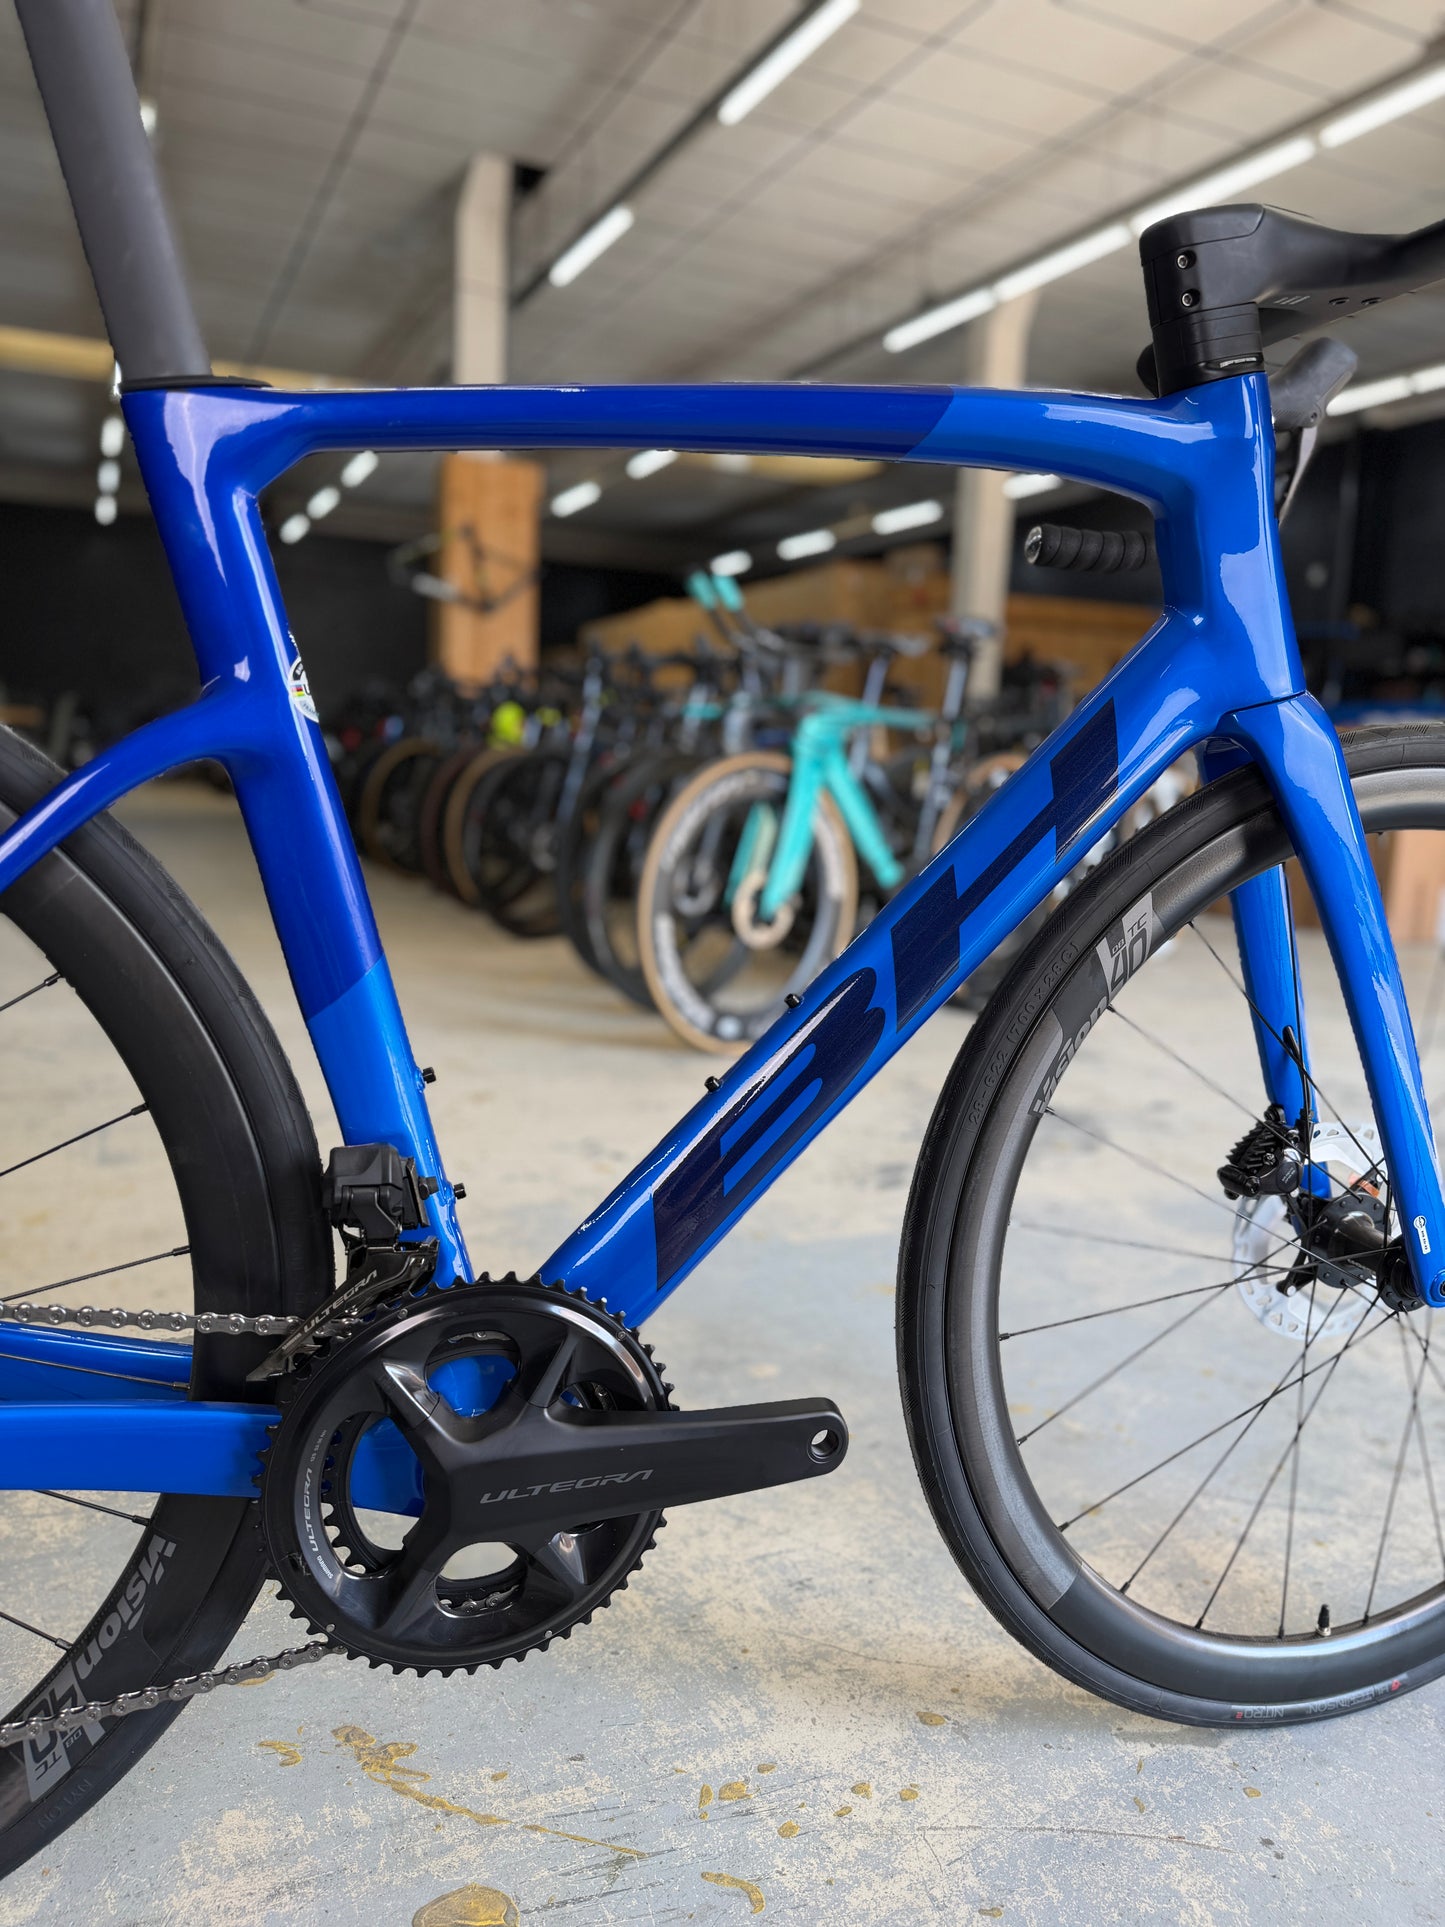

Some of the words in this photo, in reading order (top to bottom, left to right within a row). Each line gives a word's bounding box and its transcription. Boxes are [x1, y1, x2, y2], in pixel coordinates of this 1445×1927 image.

[1127, 911, 1148, 938] TC
[1111, 927, 1149, 993] 40
[653, 696, 1119, 1291] BH
[304, 1269, 378, 1333] ULTEGRA
[303, 1468, 319, 1552] ULTEGRA
[480, 1469, 655, 1504] ULTEGRA
[34, 1751, 63, 1782] TC
[38, 1778, 94, 1831] NYLON
